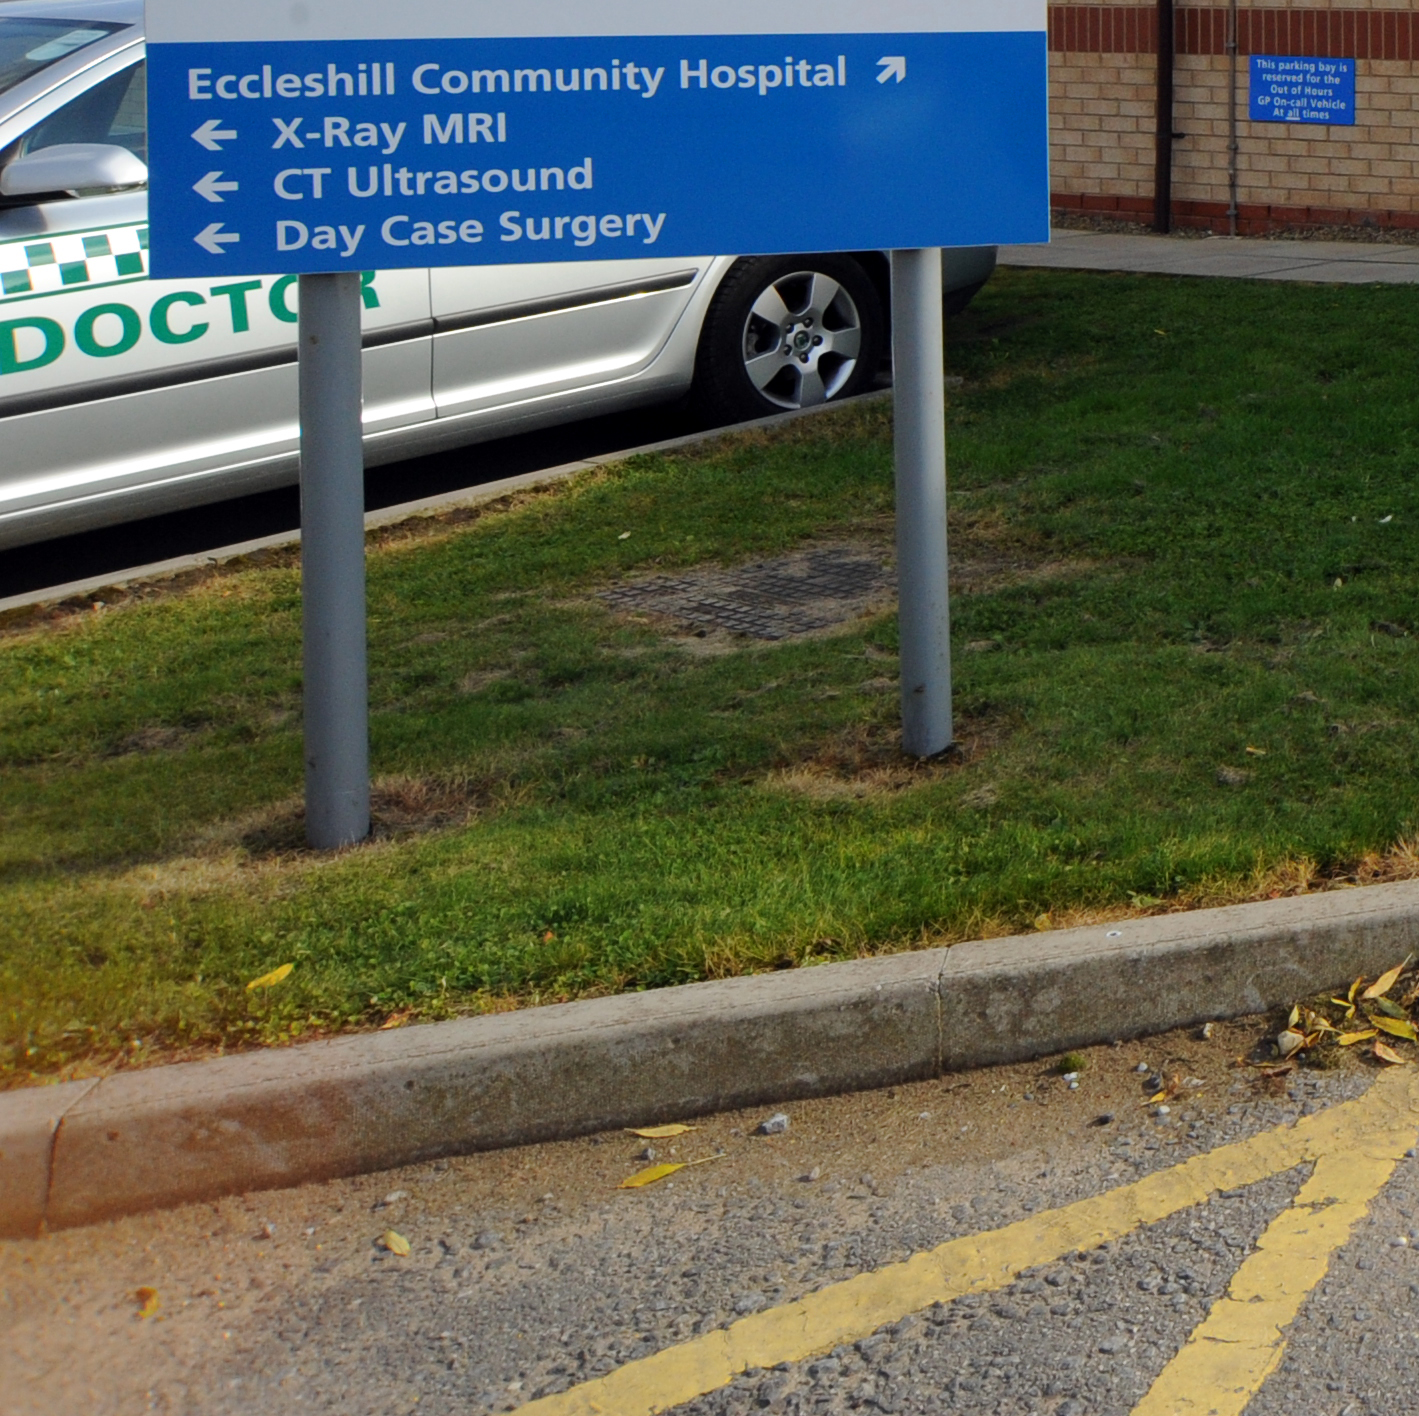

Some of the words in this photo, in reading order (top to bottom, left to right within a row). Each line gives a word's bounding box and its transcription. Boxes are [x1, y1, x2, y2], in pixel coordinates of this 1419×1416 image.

[1256, 59, 1276, 69] This
[1278, 61, 1316, 74] parking
[1318, 62, 1336, 74] bay
[1339, 63, 1348, 72] is
[188, 62, 395, 101] Eccleshill
[411, 58, 666, 99] Community
[679, 55, 847, 95] Hospital
[1262, 73, 1303, 83] reserved
[1306, 74, 1321, 83] for
[1324, 75, 1341, 84] the
[1270, 84, 1288, 94] Out
[1291, 85, 1302, 94] of
[1304, 86, 1333, 96] Hours
[1257, 96, 1271, 105] GP
[1273, 97, 1307, 107] On-call
[1310, 99, 1346, 110] Vehicle
[1273, 108, 1284, 117] At
[1286, 109, 1300, 119] all
[1302, 109, 1330, 119] times
[271, 116, 407, 155] X-Ray
[423, 112, 508, 145] MRI
[273, 168, 333, 201] CT
[347, 158, 594, 198] Ultrasound
[276, 220, 366, 258] Day
[380, 214, 485, 248] Case
[499, 210, 667, 246] Surgery
